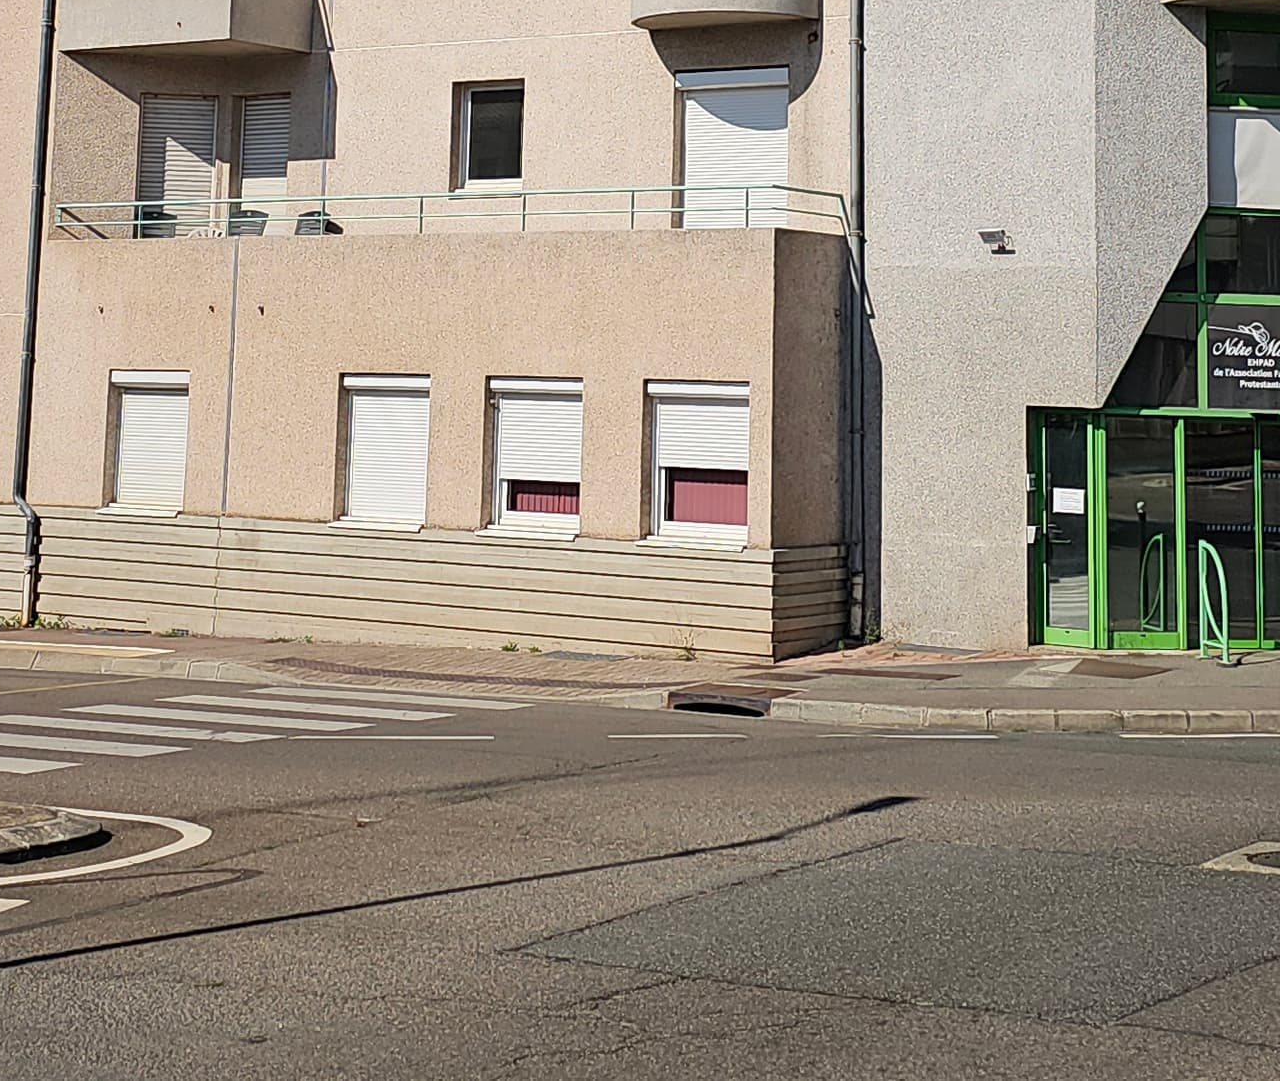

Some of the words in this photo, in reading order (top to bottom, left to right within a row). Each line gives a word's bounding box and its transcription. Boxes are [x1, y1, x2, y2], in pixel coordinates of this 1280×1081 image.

[1212, 337, 1253, 357] Notre
[1247, 358, 1276, 367] EHPAD
[1213, 367, 1224, 377] de
